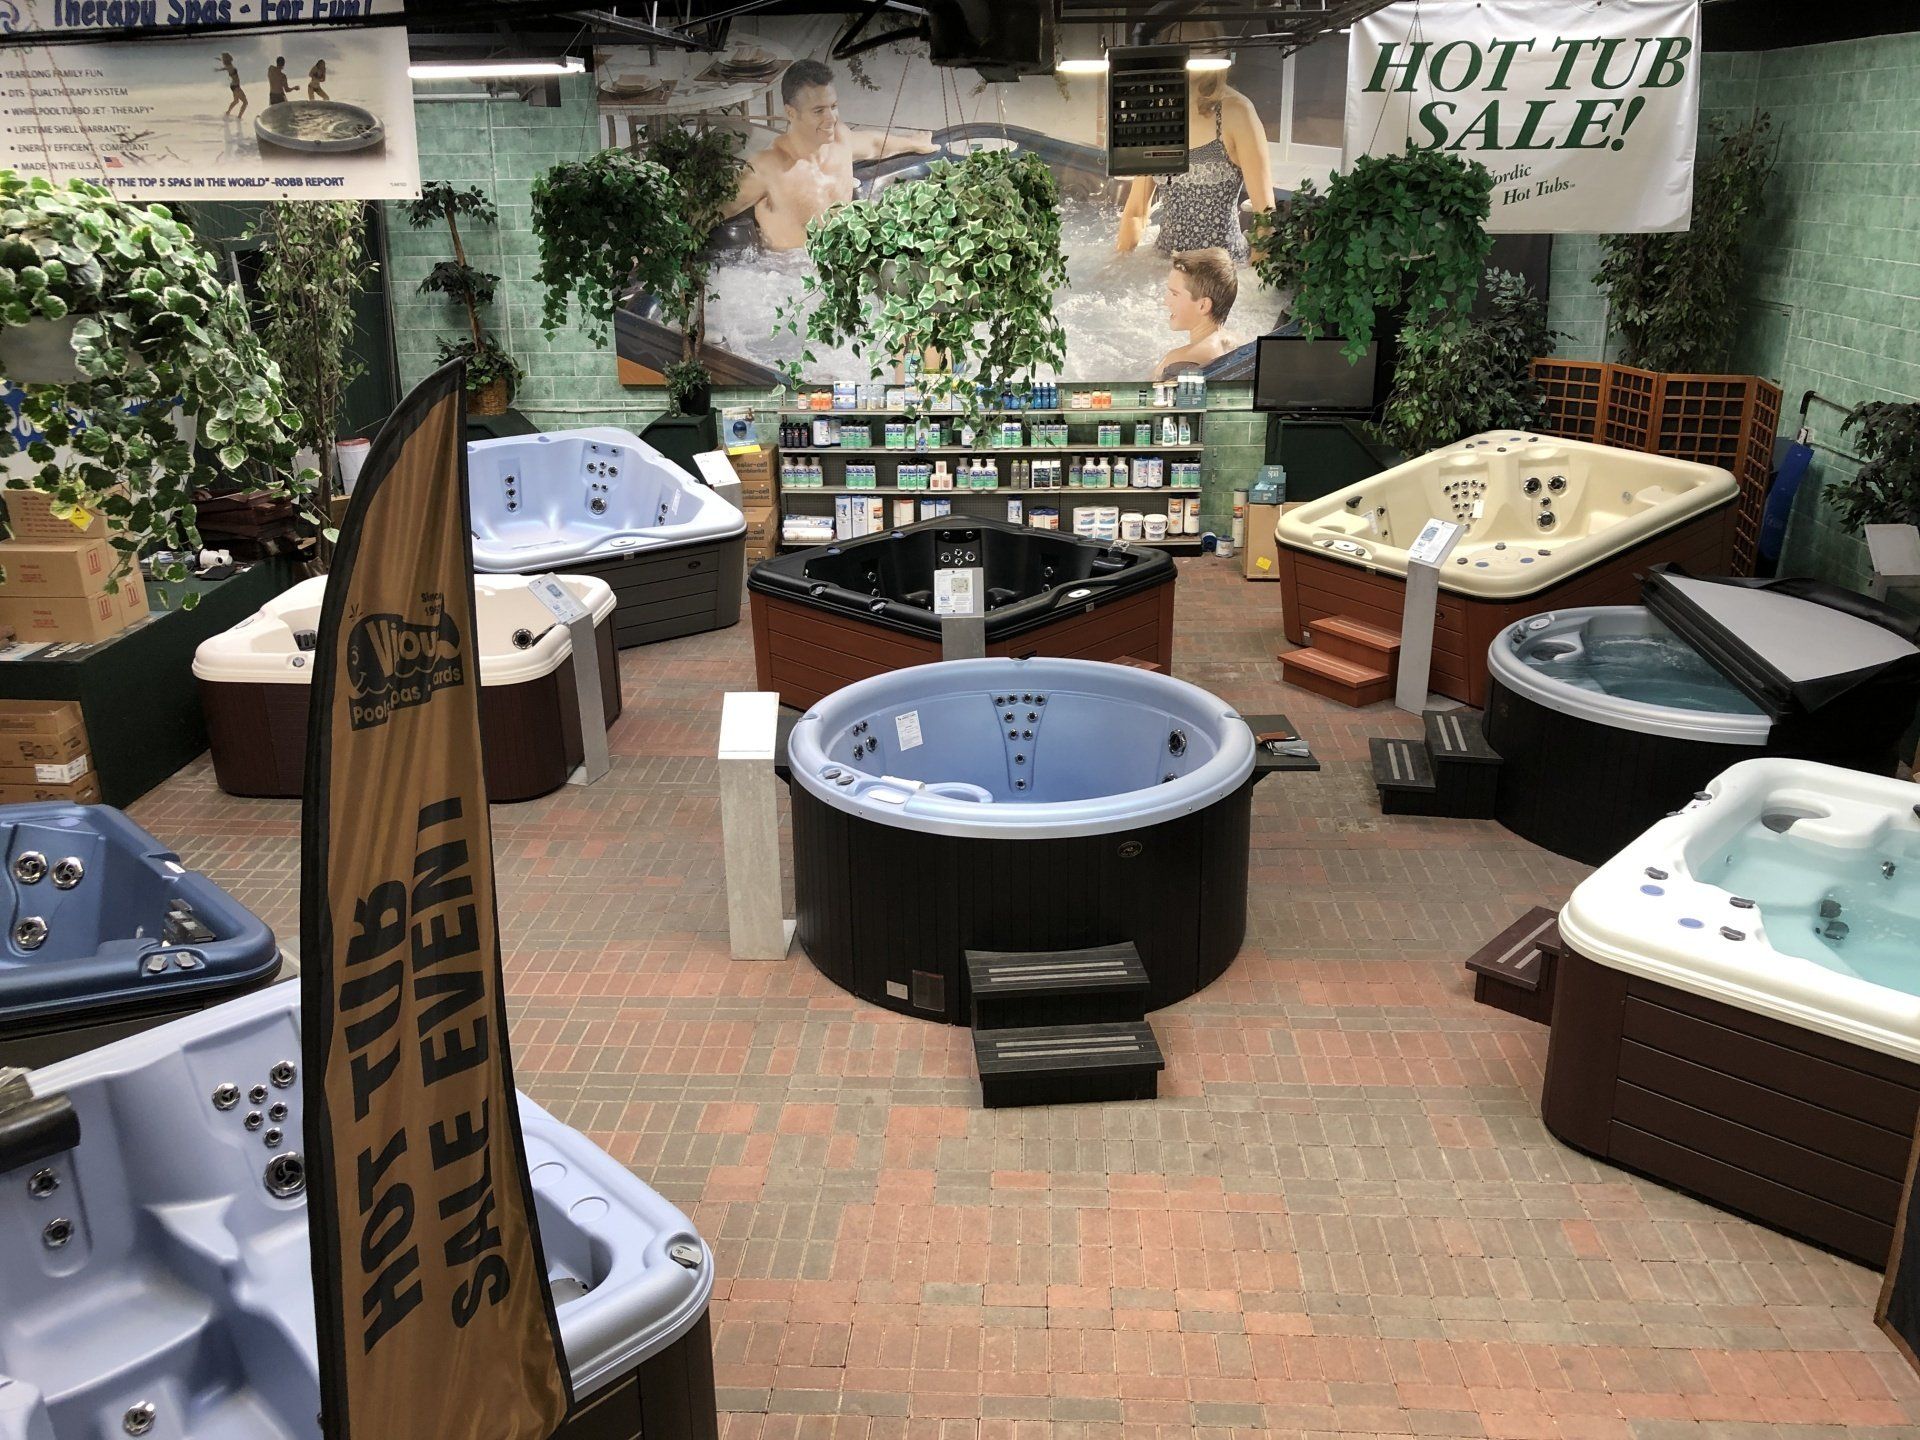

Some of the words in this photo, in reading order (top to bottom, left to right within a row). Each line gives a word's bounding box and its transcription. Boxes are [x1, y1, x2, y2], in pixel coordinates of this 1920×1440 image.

[261, 0, 303, 21] For
[1362, 37, 1537, 93] HOT
[1545, 36, 1693, 91] TUB
[53, 69, 83, 78] FAMILY
[85, 69, 104, 77] FUN
[8, 89, 25, 97] DTS
[30, 88, 53, 97] DUAL
[52, 87, 92, 97] THERAPY
[94, 87, 128, 96] SYSTEM
[12, 107, 62, 116] WHIRLPOOL
[62, 107, 90, 115] TURBO
[92, 106, 107, 115] JET
[14, 126, 54, 134] LIFETIME
[54, 126, 80, 134] SHELL
[1406, 95, 1646, 151] SALE!
[18, 144, 52, 153] ENERGY
[54, 143, 94, 152] EFFICIENT
[100, 142, 149, 152] COMPLIANT
[21, 162, 46, 171] MADE
[58, 162, 75, 170] THE
[102, 178, 115, 187] OF
[118, 178, 136, 187] THE
[137, 178, 157, 187] TOP
[159, 178, 166, 187] 5
[168, 178, 192, 187] SPAS
[194, 178, 205, 187] IN
[205, 178, 226, 187] THE
[305, 177, 345, 187] REPORT
[1502, 188, 1531, 206] Hot
[339, 879, 408, 1123] TUB
[428, 1097, 511, 1329] SALE
[358, 1127, 424, 1355] HOT
